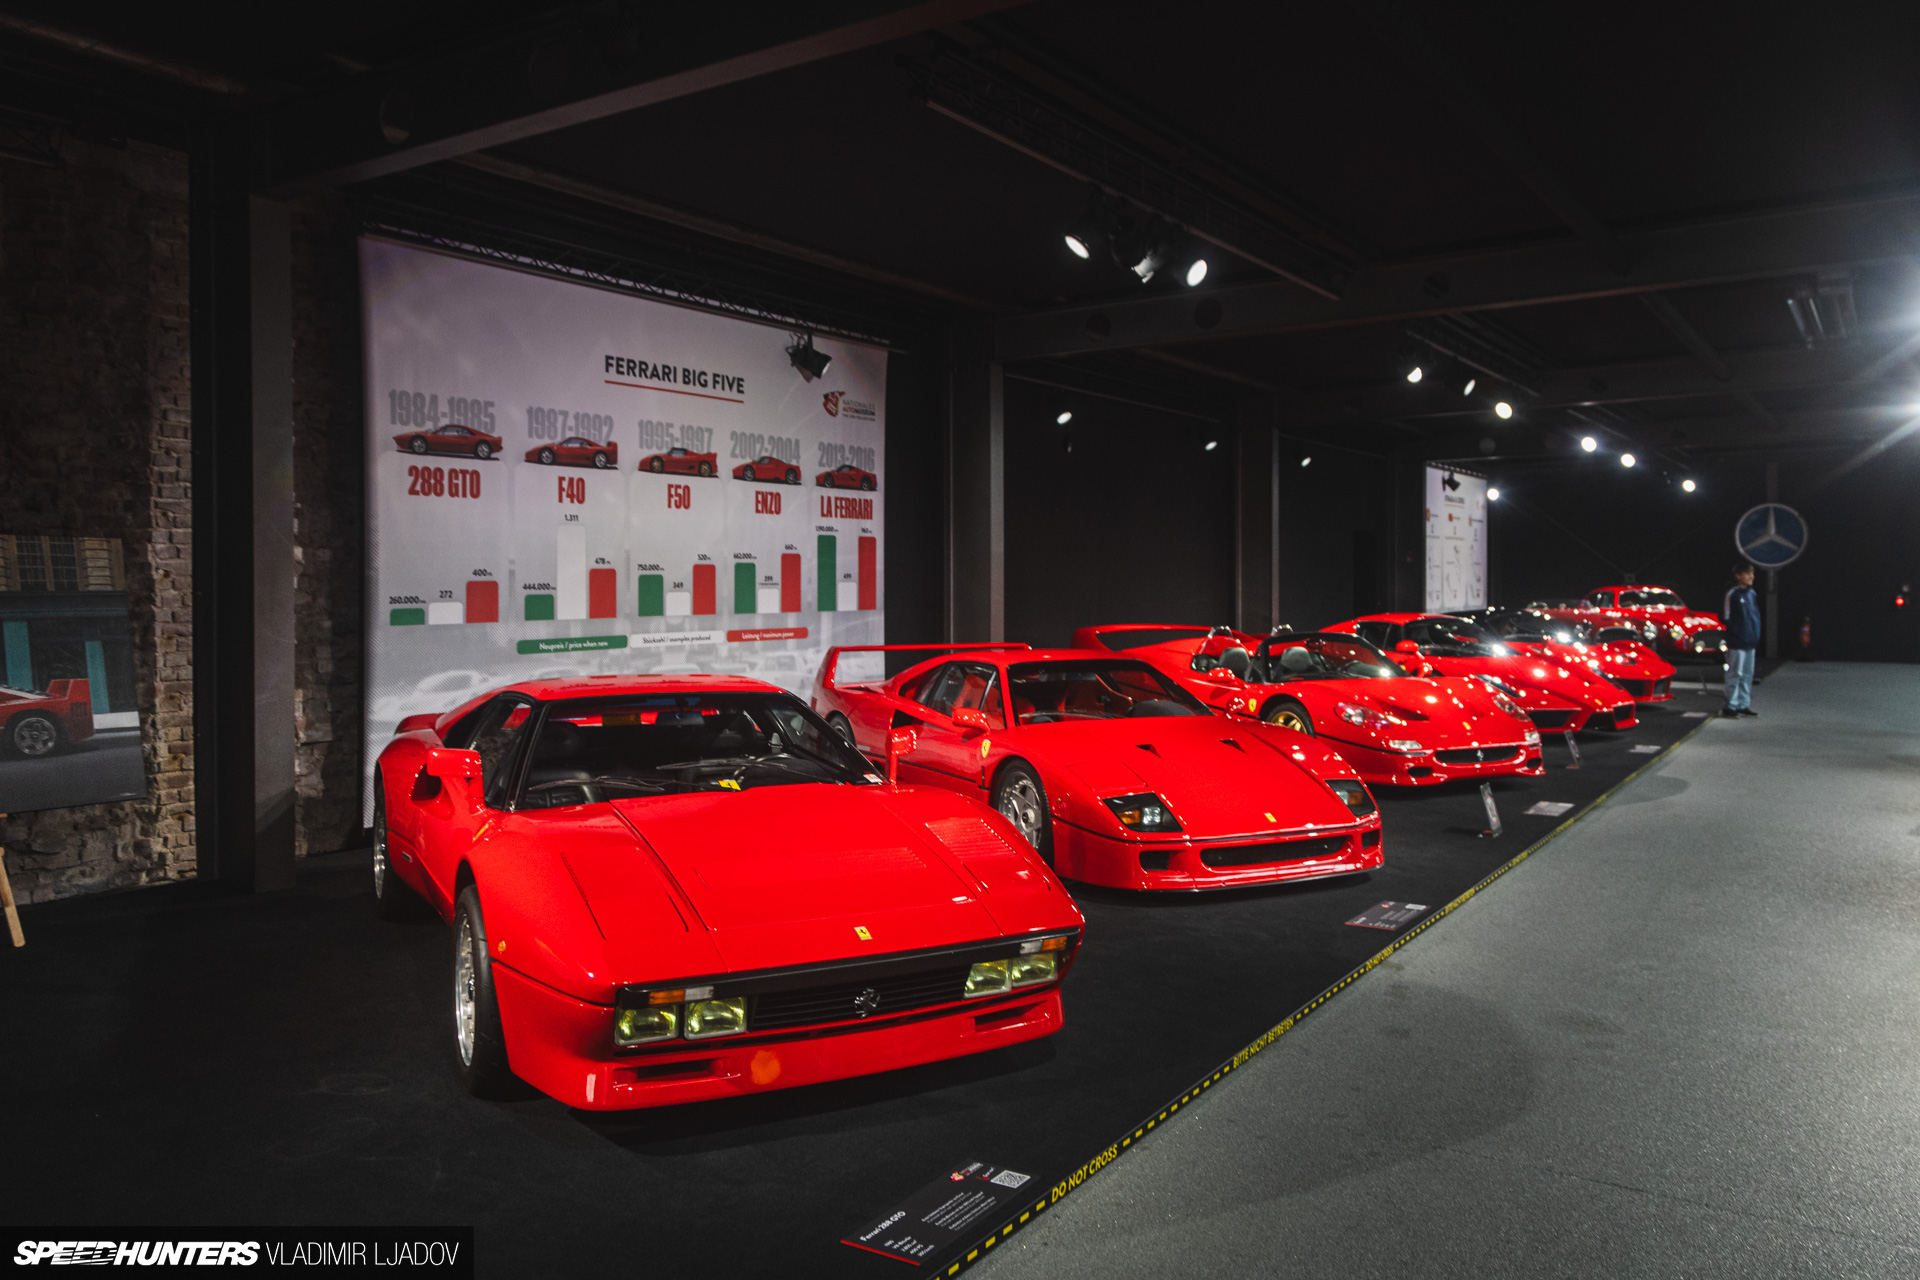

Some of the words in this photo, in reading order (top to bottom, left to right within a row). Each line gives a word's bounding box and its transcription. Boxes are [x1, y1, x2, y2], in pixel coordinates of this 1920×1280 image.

[604, 355, 677, 383] FERRARI
[683, 368, 708, 388] BIG
[712, 373, 745, 395] FIVE
[388, 389, 496, 435] 1984-1985
[526, 405, 614, 443] 1987-1992
[637, 419, 714, 453] 1995-1997
[730, 430, 801, 464] 2002-2004
[818, 441, 876, 472] 2013-2016
[407, 465, 445, 498] 288
[447, 468, 482, 499] GTO
[557, 476, 586, 505] F40
[667, 484, 691, 510] F50
[755, 490, 782, 515] ENZO
[820, 495, 833, 518] LA
[834, 497, 873, 520] FERRARI
[564, 514, 579, 522] 1.311
[472, 568, 487, 576] 400
[672, 581, 684, 589] 349
[388, 596, 420, 604] 260.000
[439, 590, 453, 598] 272
[568, 641, 582, 651] price
[583, 640, 597, 648] when
[1233, 1048, 1249, 1069] BITTE
[1250, 1034, 1267, 1057] NICHT
[1268, 1015, 1294, 1043] BETRETEN
[1051, 1181, 1067, 1203] DO
[1068, 1164, 1088, 1191] NOT
[1088, 1144, 1118, 1175] CROSS
[890, 1211, 906, 1222] GTO
